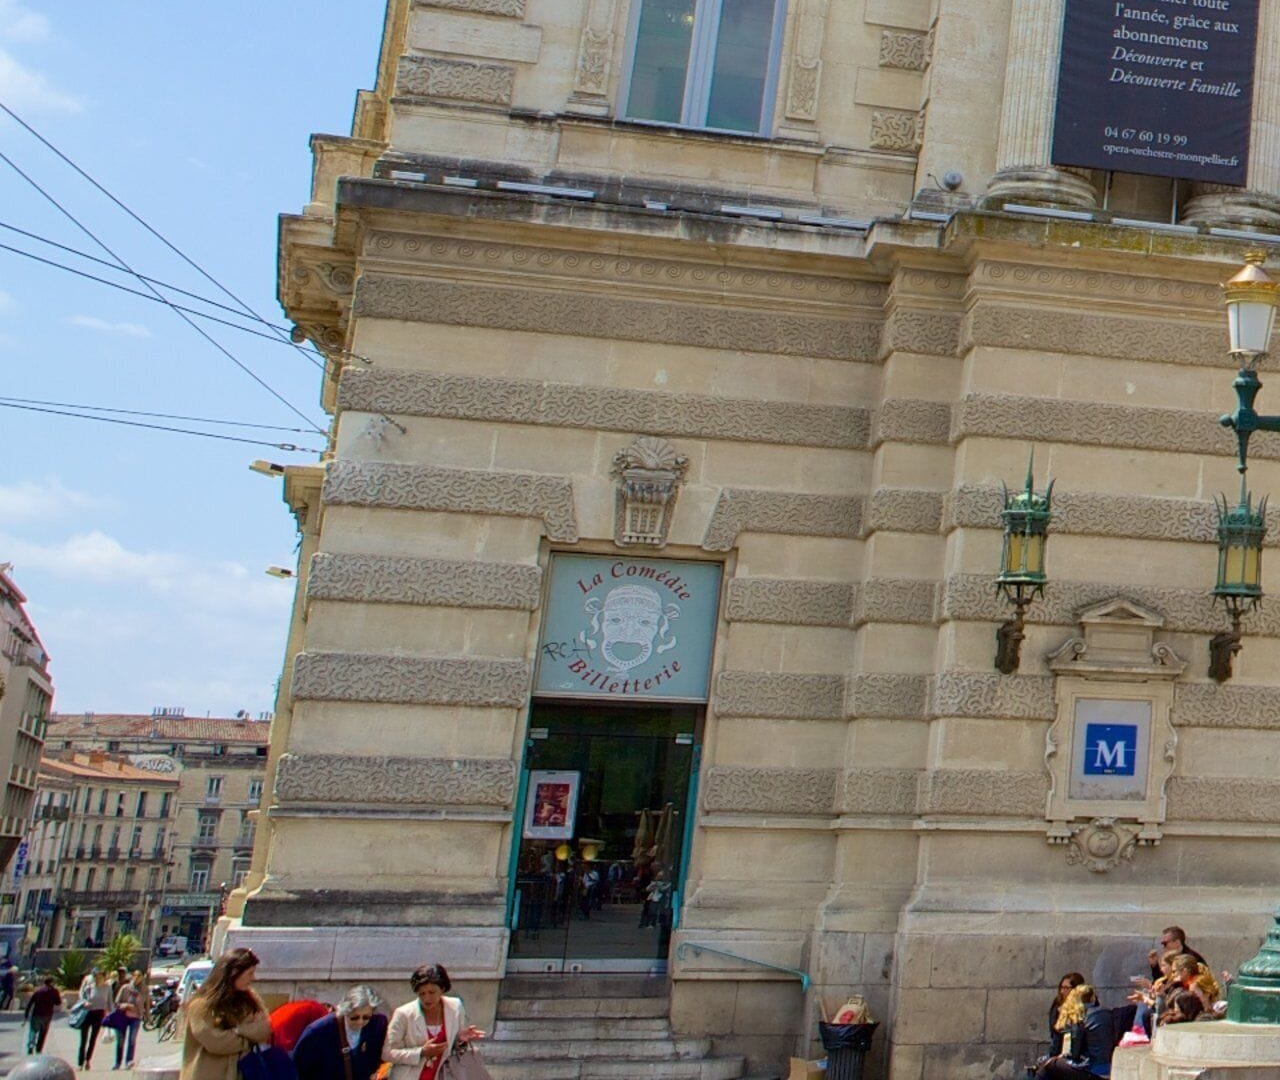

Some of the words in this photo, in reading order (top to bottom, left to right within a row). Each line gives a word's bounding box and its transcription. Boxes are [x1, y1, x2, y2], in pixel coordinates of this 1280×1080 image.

[1115, 3, 1169, 25] l'année,
[1173, 14, 1211, 31] grâce
[1214, 21, 1239, 33] aux
[1113, 25, 1209, 50] abonnements
[1111, 46, 1188, 69] Découverte
[1190, 61, 1205, 72] et
[1109, 67, 1186, 91] Découverte
[1189, 78, 1242, 98] Famille
[1104, 126, 1118, 138] 04
[1121, 128, 1137, 140] 67
[1139, 130, 1153, 142] 60
[1157, 133, 1170, 145] 19
[1173, 134, 1188, 146] 99
[577, 572, 603, 595] La
[611, 561, 691, 601] Comédie
[568, 658, 682, 694] Billetterie
[1093, 739, 1127, 768] M
[14, 842, 28, 877] HOTEL
